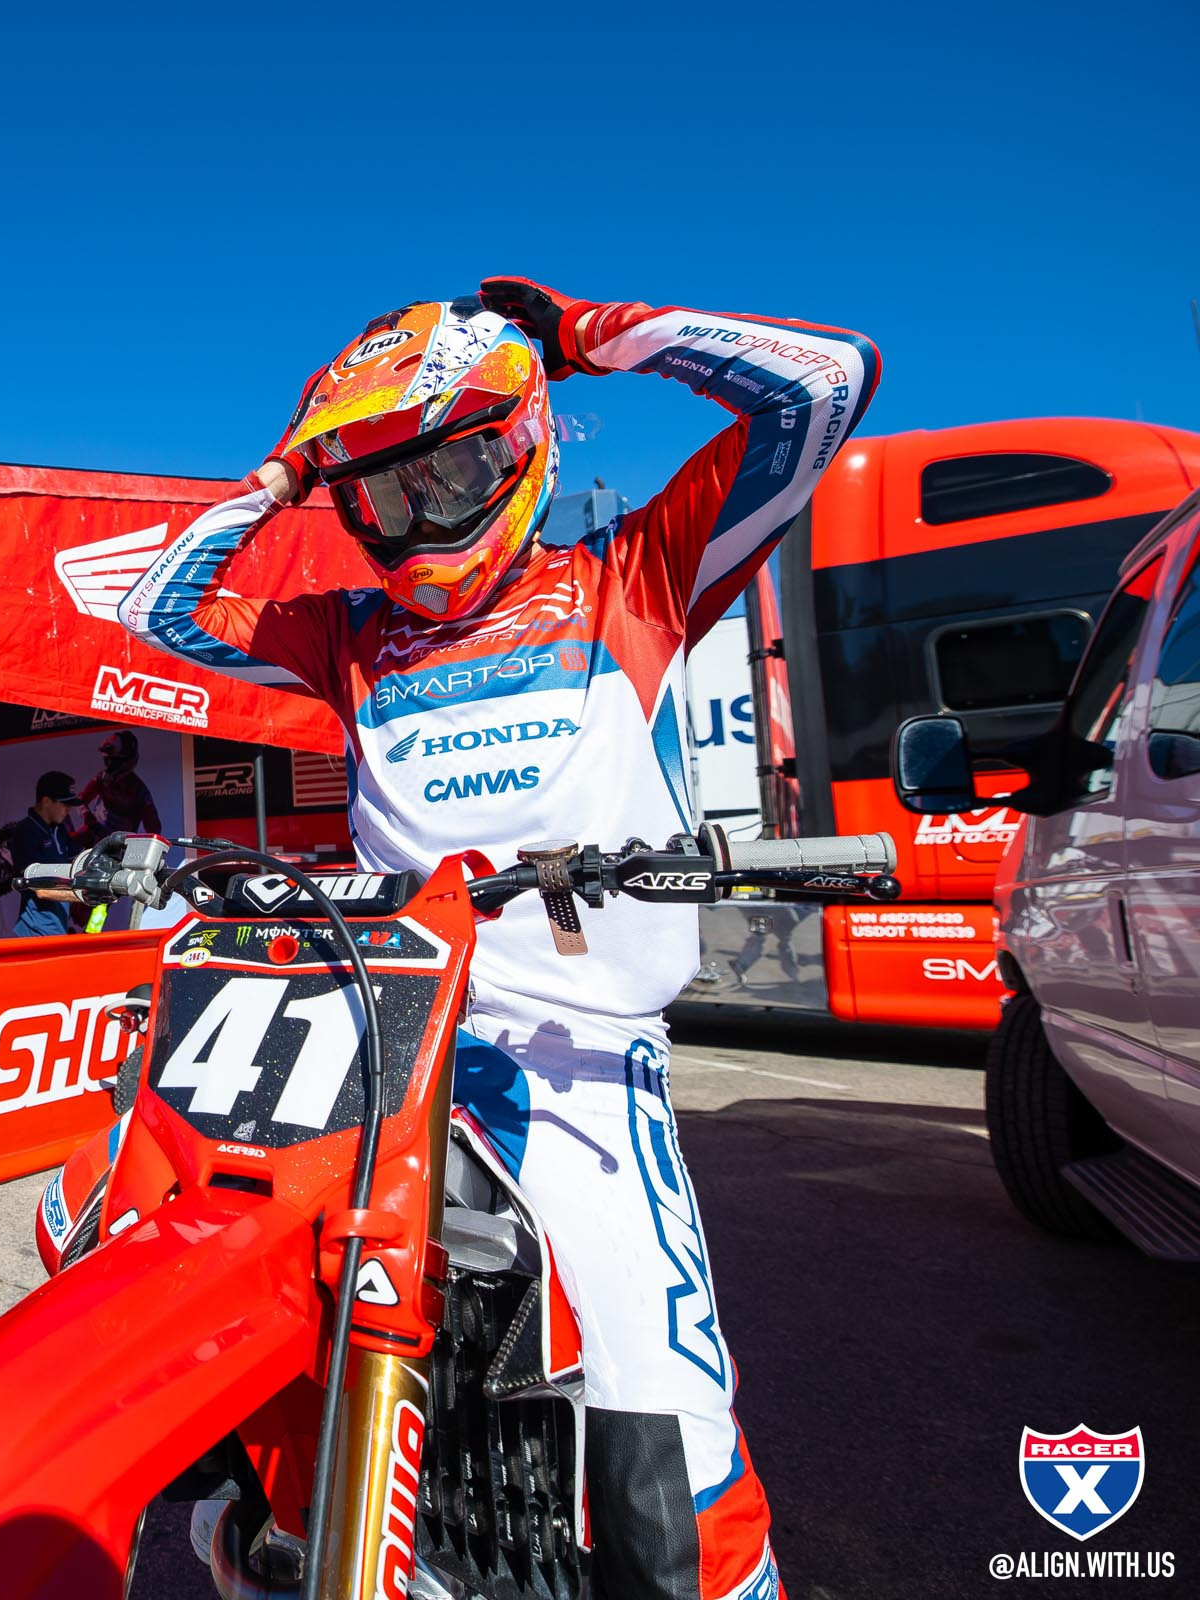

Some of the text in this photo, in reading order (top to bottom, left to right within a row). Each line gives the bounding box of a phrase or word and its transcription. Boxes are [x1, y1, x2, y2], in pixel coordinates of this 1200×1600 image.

[347, 332, 405, 366] Arai
[93, 665, 210, 719] MCR
[375, 653, 555, 710] SMARTOP
[90, 698, 209, 729] MOTOCONCEPTSRACING
[421, 717, 582, 757] HONDA
[423, 766, 540, 803] CANVAS
[623, 872, 712, 890] ARC
[851, 925, 907, 937] USDOT
[157, 977, 382, 1130] 41
